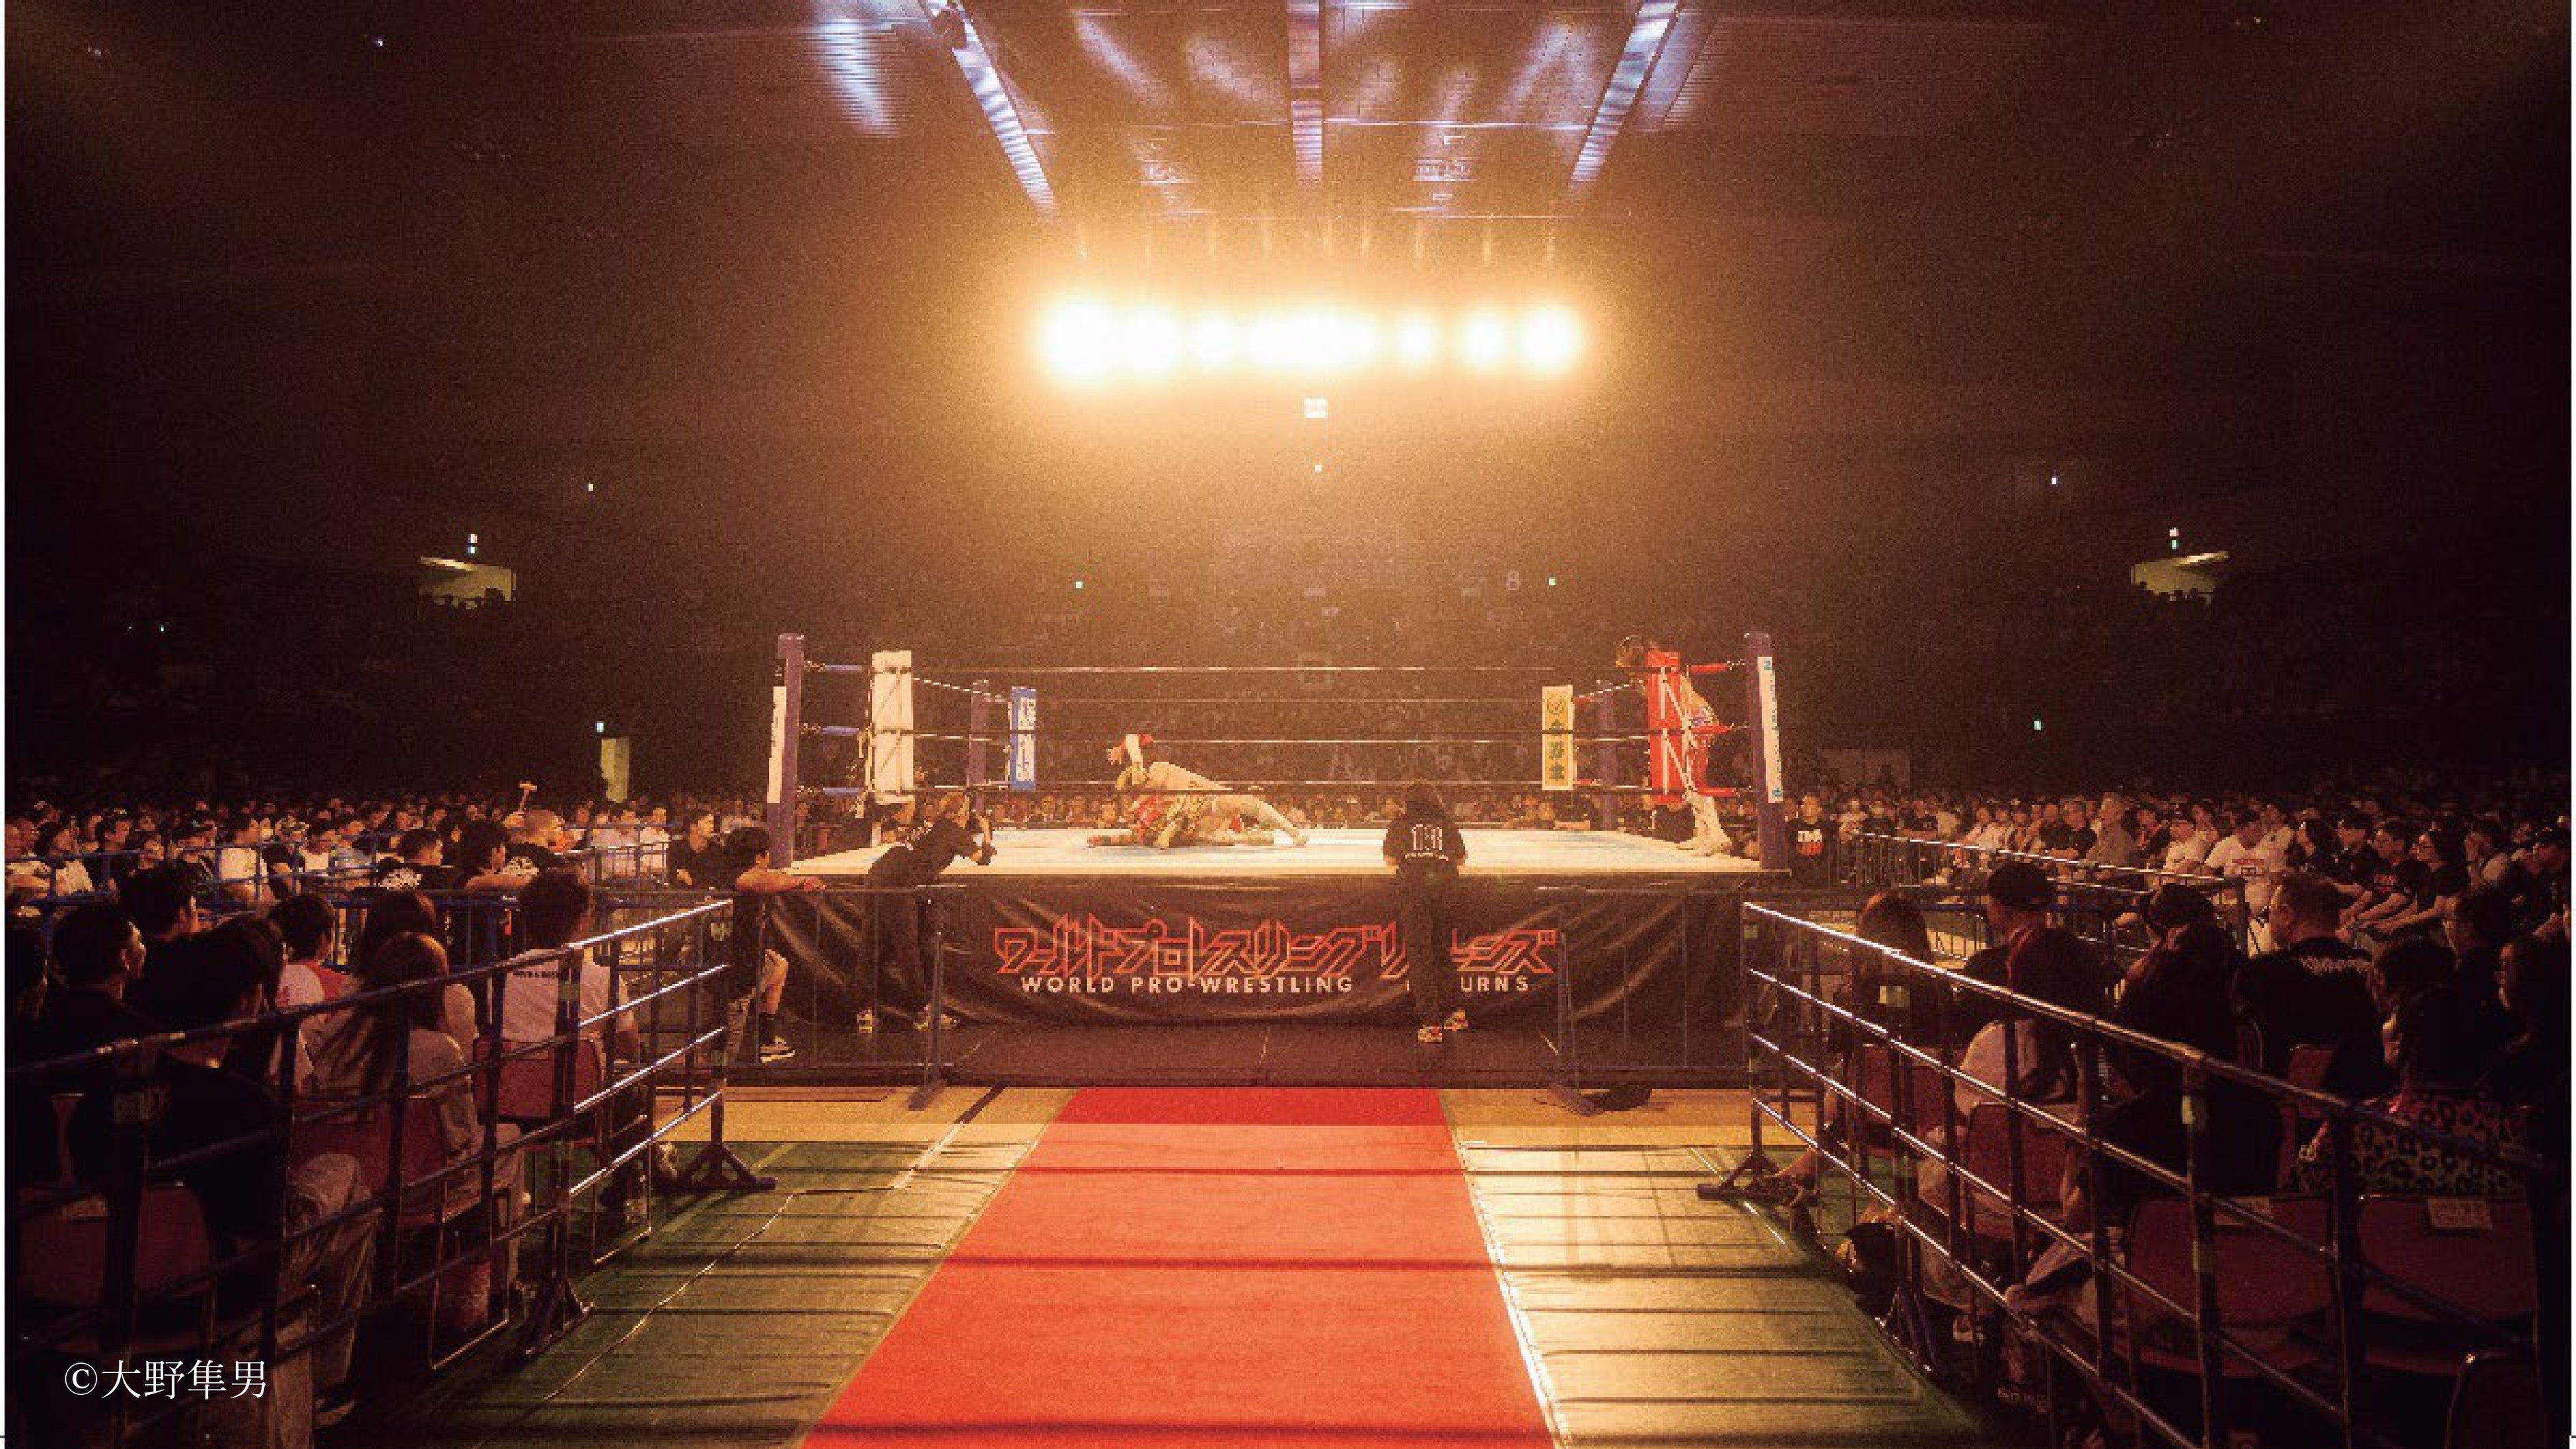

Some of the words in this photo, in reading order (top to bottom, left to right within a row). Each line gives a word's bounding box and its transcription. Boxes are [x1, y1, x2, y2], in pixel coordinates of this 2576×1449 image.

[1020, 977, 1114, 993] WORLD
[1131, 977, 1353, 993] PRO-WRESTLING
[1407, 977, 1528, 992] URNS
